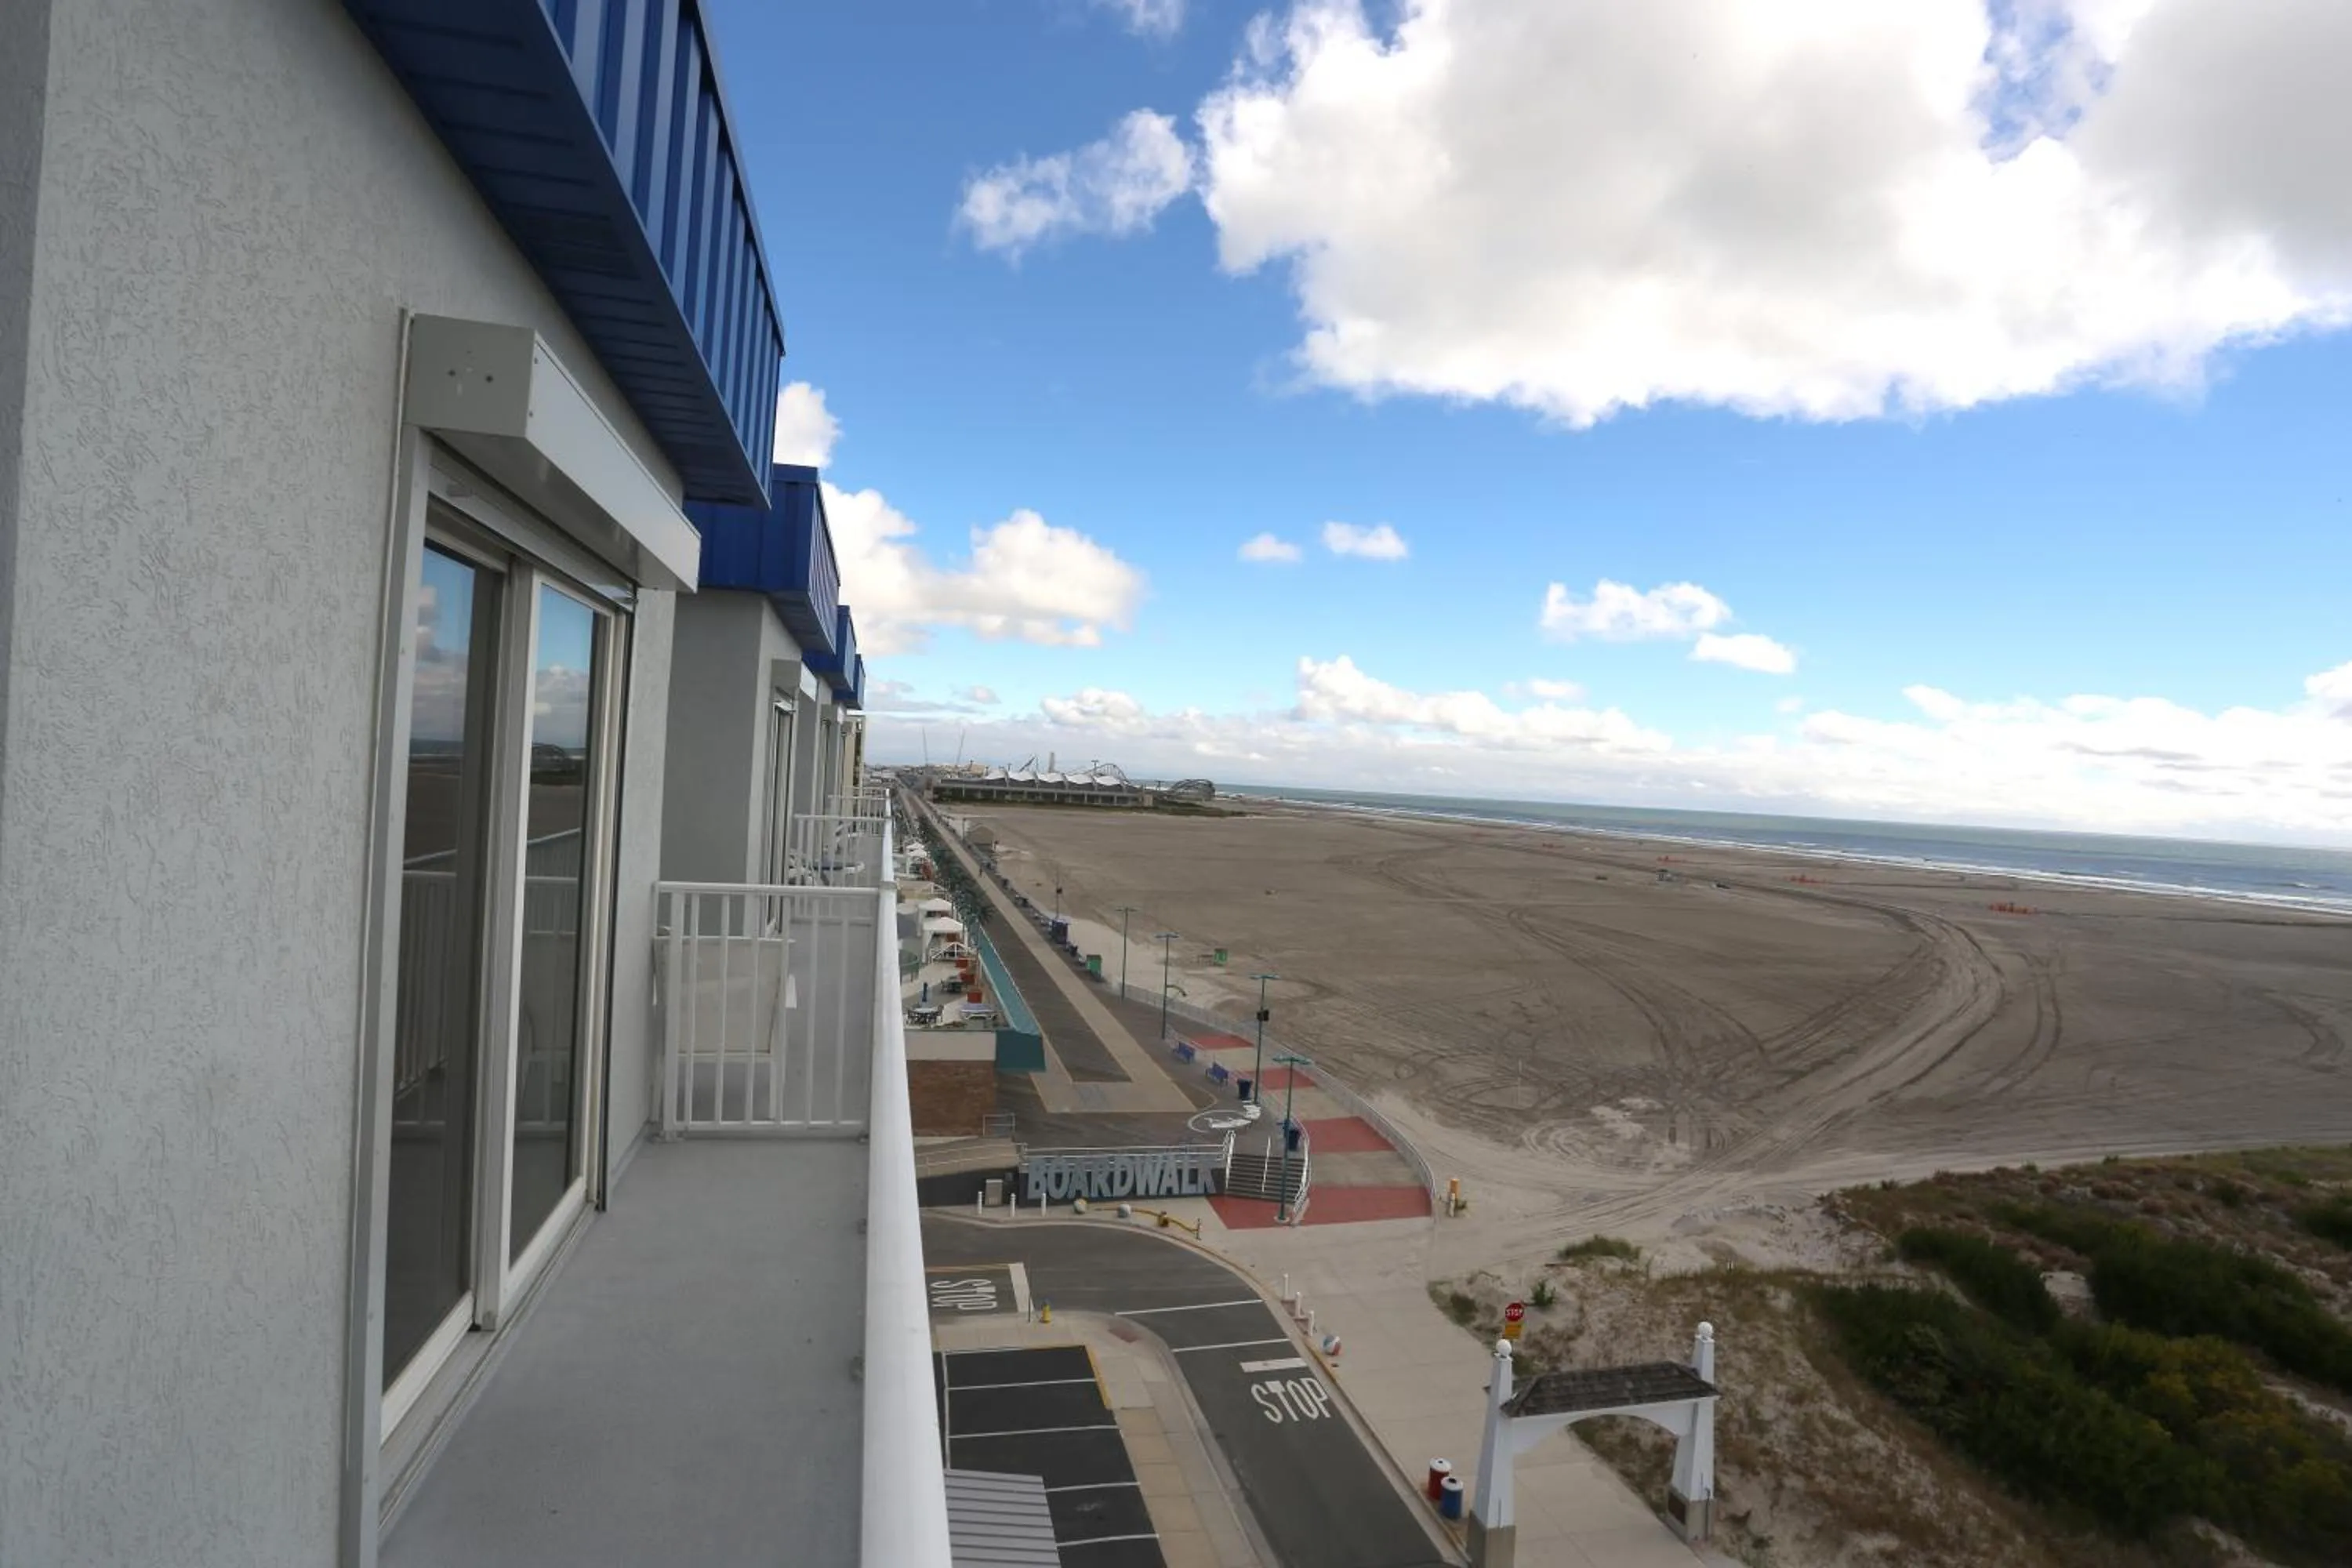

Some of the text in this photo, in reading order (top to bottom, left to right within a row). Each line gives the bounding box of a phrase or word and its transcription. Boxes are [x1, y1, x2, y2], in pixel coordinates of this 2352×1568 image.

[1026, 1156, 1216, 1200] BOARDWALK
[930, 1279, 997, 1310] STOP
[1505, 1308, 1523, 1317] STOP
[1250, 1377, 1330, 1424] STOP
